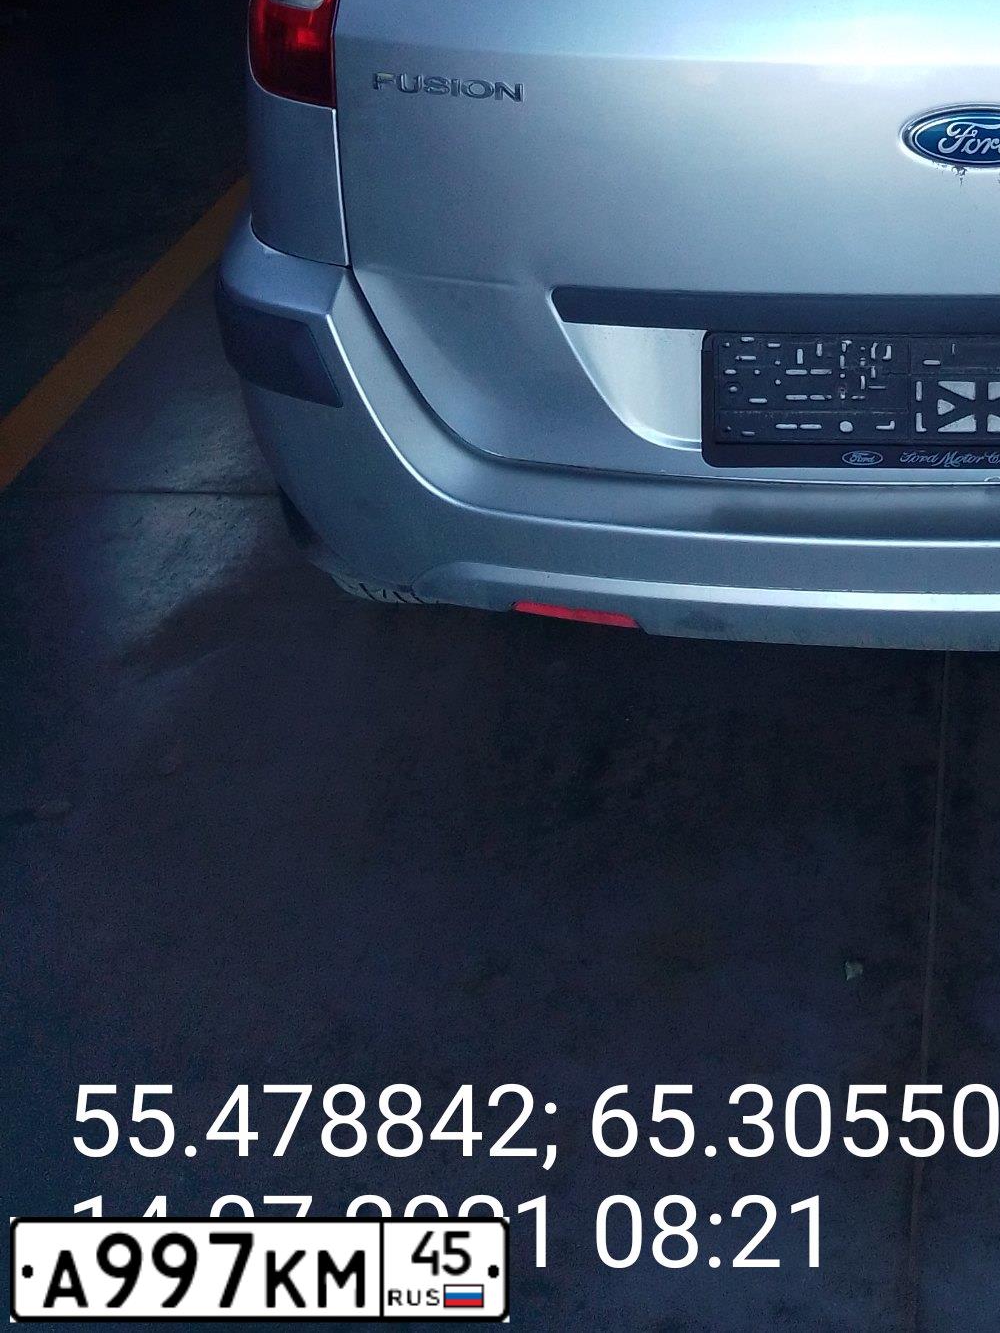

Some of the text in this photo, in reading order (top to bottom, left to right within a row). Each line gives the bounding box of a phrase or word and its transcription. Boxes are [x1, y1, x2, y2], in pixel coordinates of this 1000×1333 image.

[372, 70, 525, 103] FUSION
[900, 451, 939, 464] Ford
[931, 451, 985, 468] Motor
